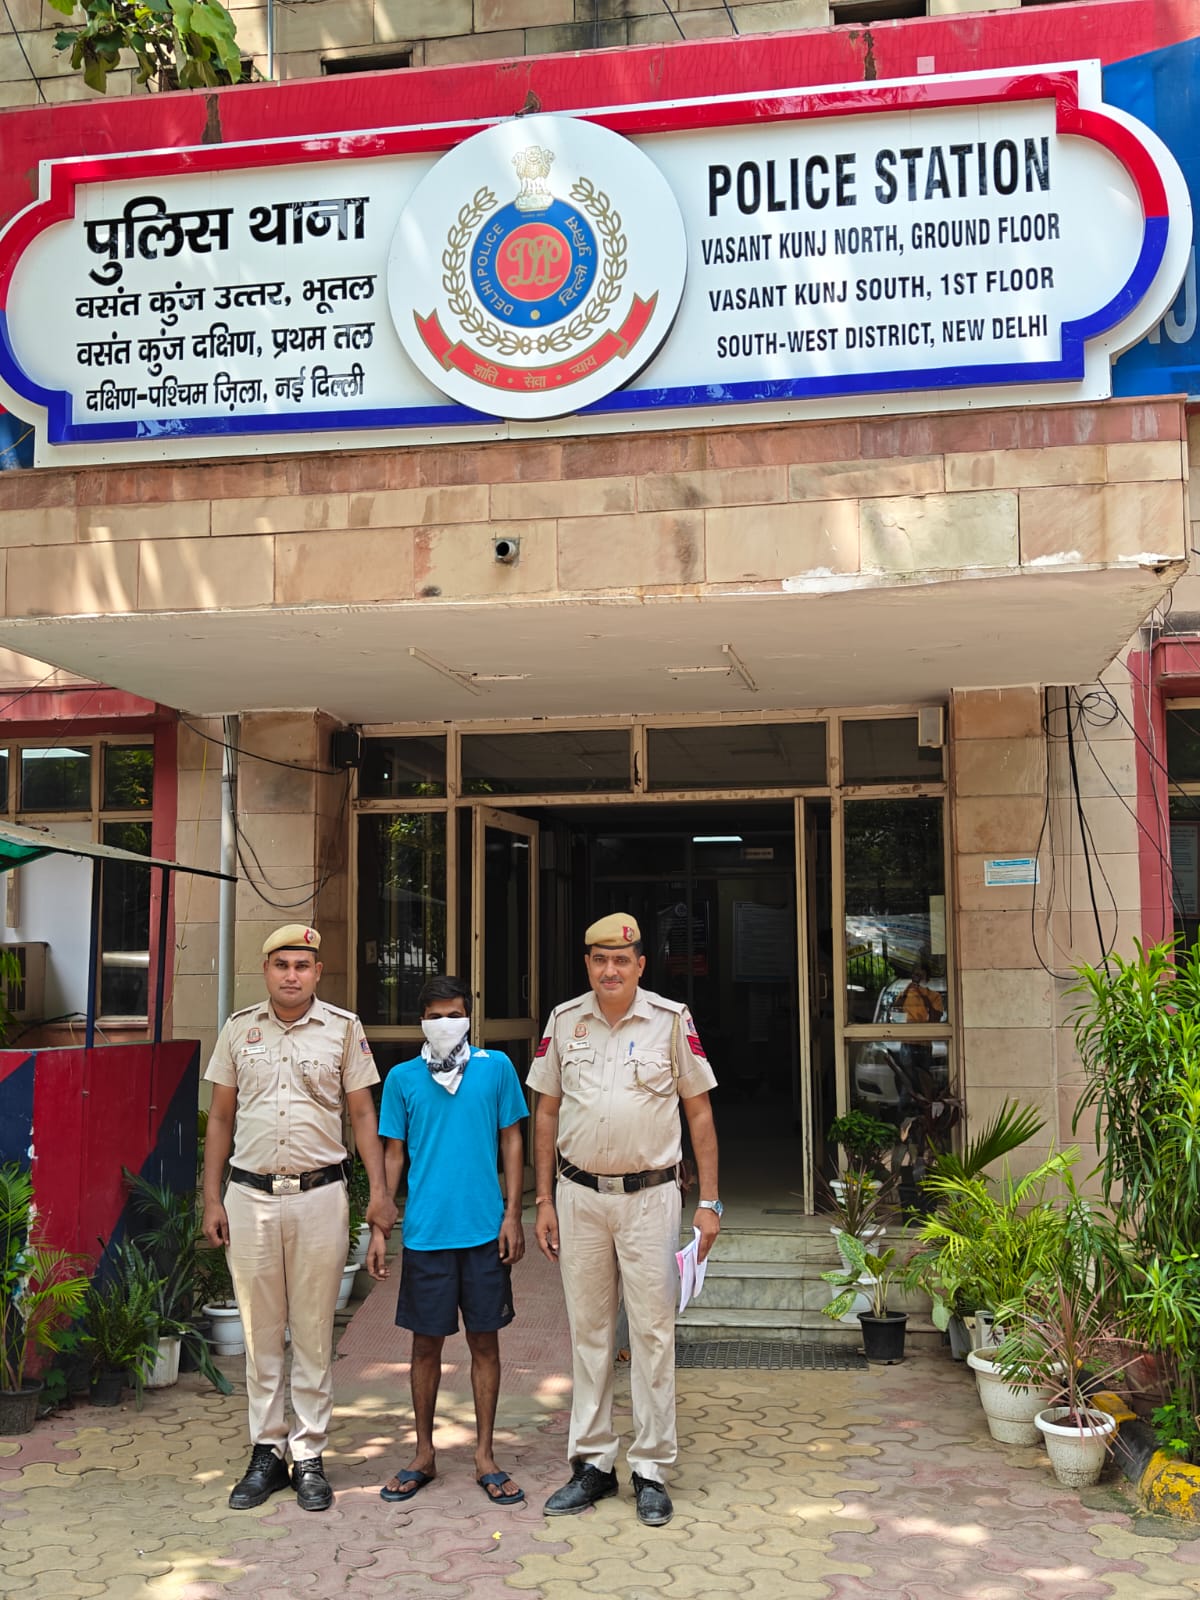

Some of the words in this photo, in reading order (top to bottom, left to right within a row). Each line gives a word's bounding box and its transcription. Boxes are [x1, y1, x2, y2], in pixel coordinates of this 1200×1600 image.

[708, 151, 858, 217] POLICE
[874, 136, 1051, 204] STATION
[84, 195, 234, 286] पुलिस
[249, 196, 370, 245] थाना
[477, 223, 505, 278] POLICE
[563, 215, 593, 257] पुलिस
[701, 233, 772, 266] VASANT
[779, 229, 827, 260] KUNJ
[834, 224, 905, 257] NORTH,
[911, 218, 990, 250] GROUND
[998, 212, 1061, 244] FLOOR
[75, 286, 142, 319] वसंत
[148, 281, 206, 327] कुंज
[213, 281, 292, 309] उत्तर,
[302, 274, 378, 315] भूतल
[479, 280, 515, 316] DELHI
[558, 264, 588, 307] दिल्ली
[709, 284, 787, 312] VASANT
[795, 280, 848, 306] KUNJ
[856, 275, 932, 301] SOUTH,
[940, 271, 978, 296] 1ST
[986, 266, 1054, 293] FLOOR
[76, 331, 132, 367] वसंत
[137, 327, 185, 377] कुंज
[191, 322, 263, 359] दक्षिण,
[271, 325, 327, 359] प्रथम
[332, 321, 375, 350] तल
[717, 327, 839, 358] SOUTH-WEST
[846, 321, 935, 349] DISTRICT,
[942, 318, 985, 343] NEW
[992, 314, 1048, 340] DELHI
[86, 375, 209, 412] दक्षिण-पश्चिम
[213, 371, 268, 411] ज़िला,
[274, 365, 306, 403] नई
[310, 362, 365, 398] दिल्ली
[524, 372, 547, 388] सेवा
[568, 354, 598, 375] न्याय
